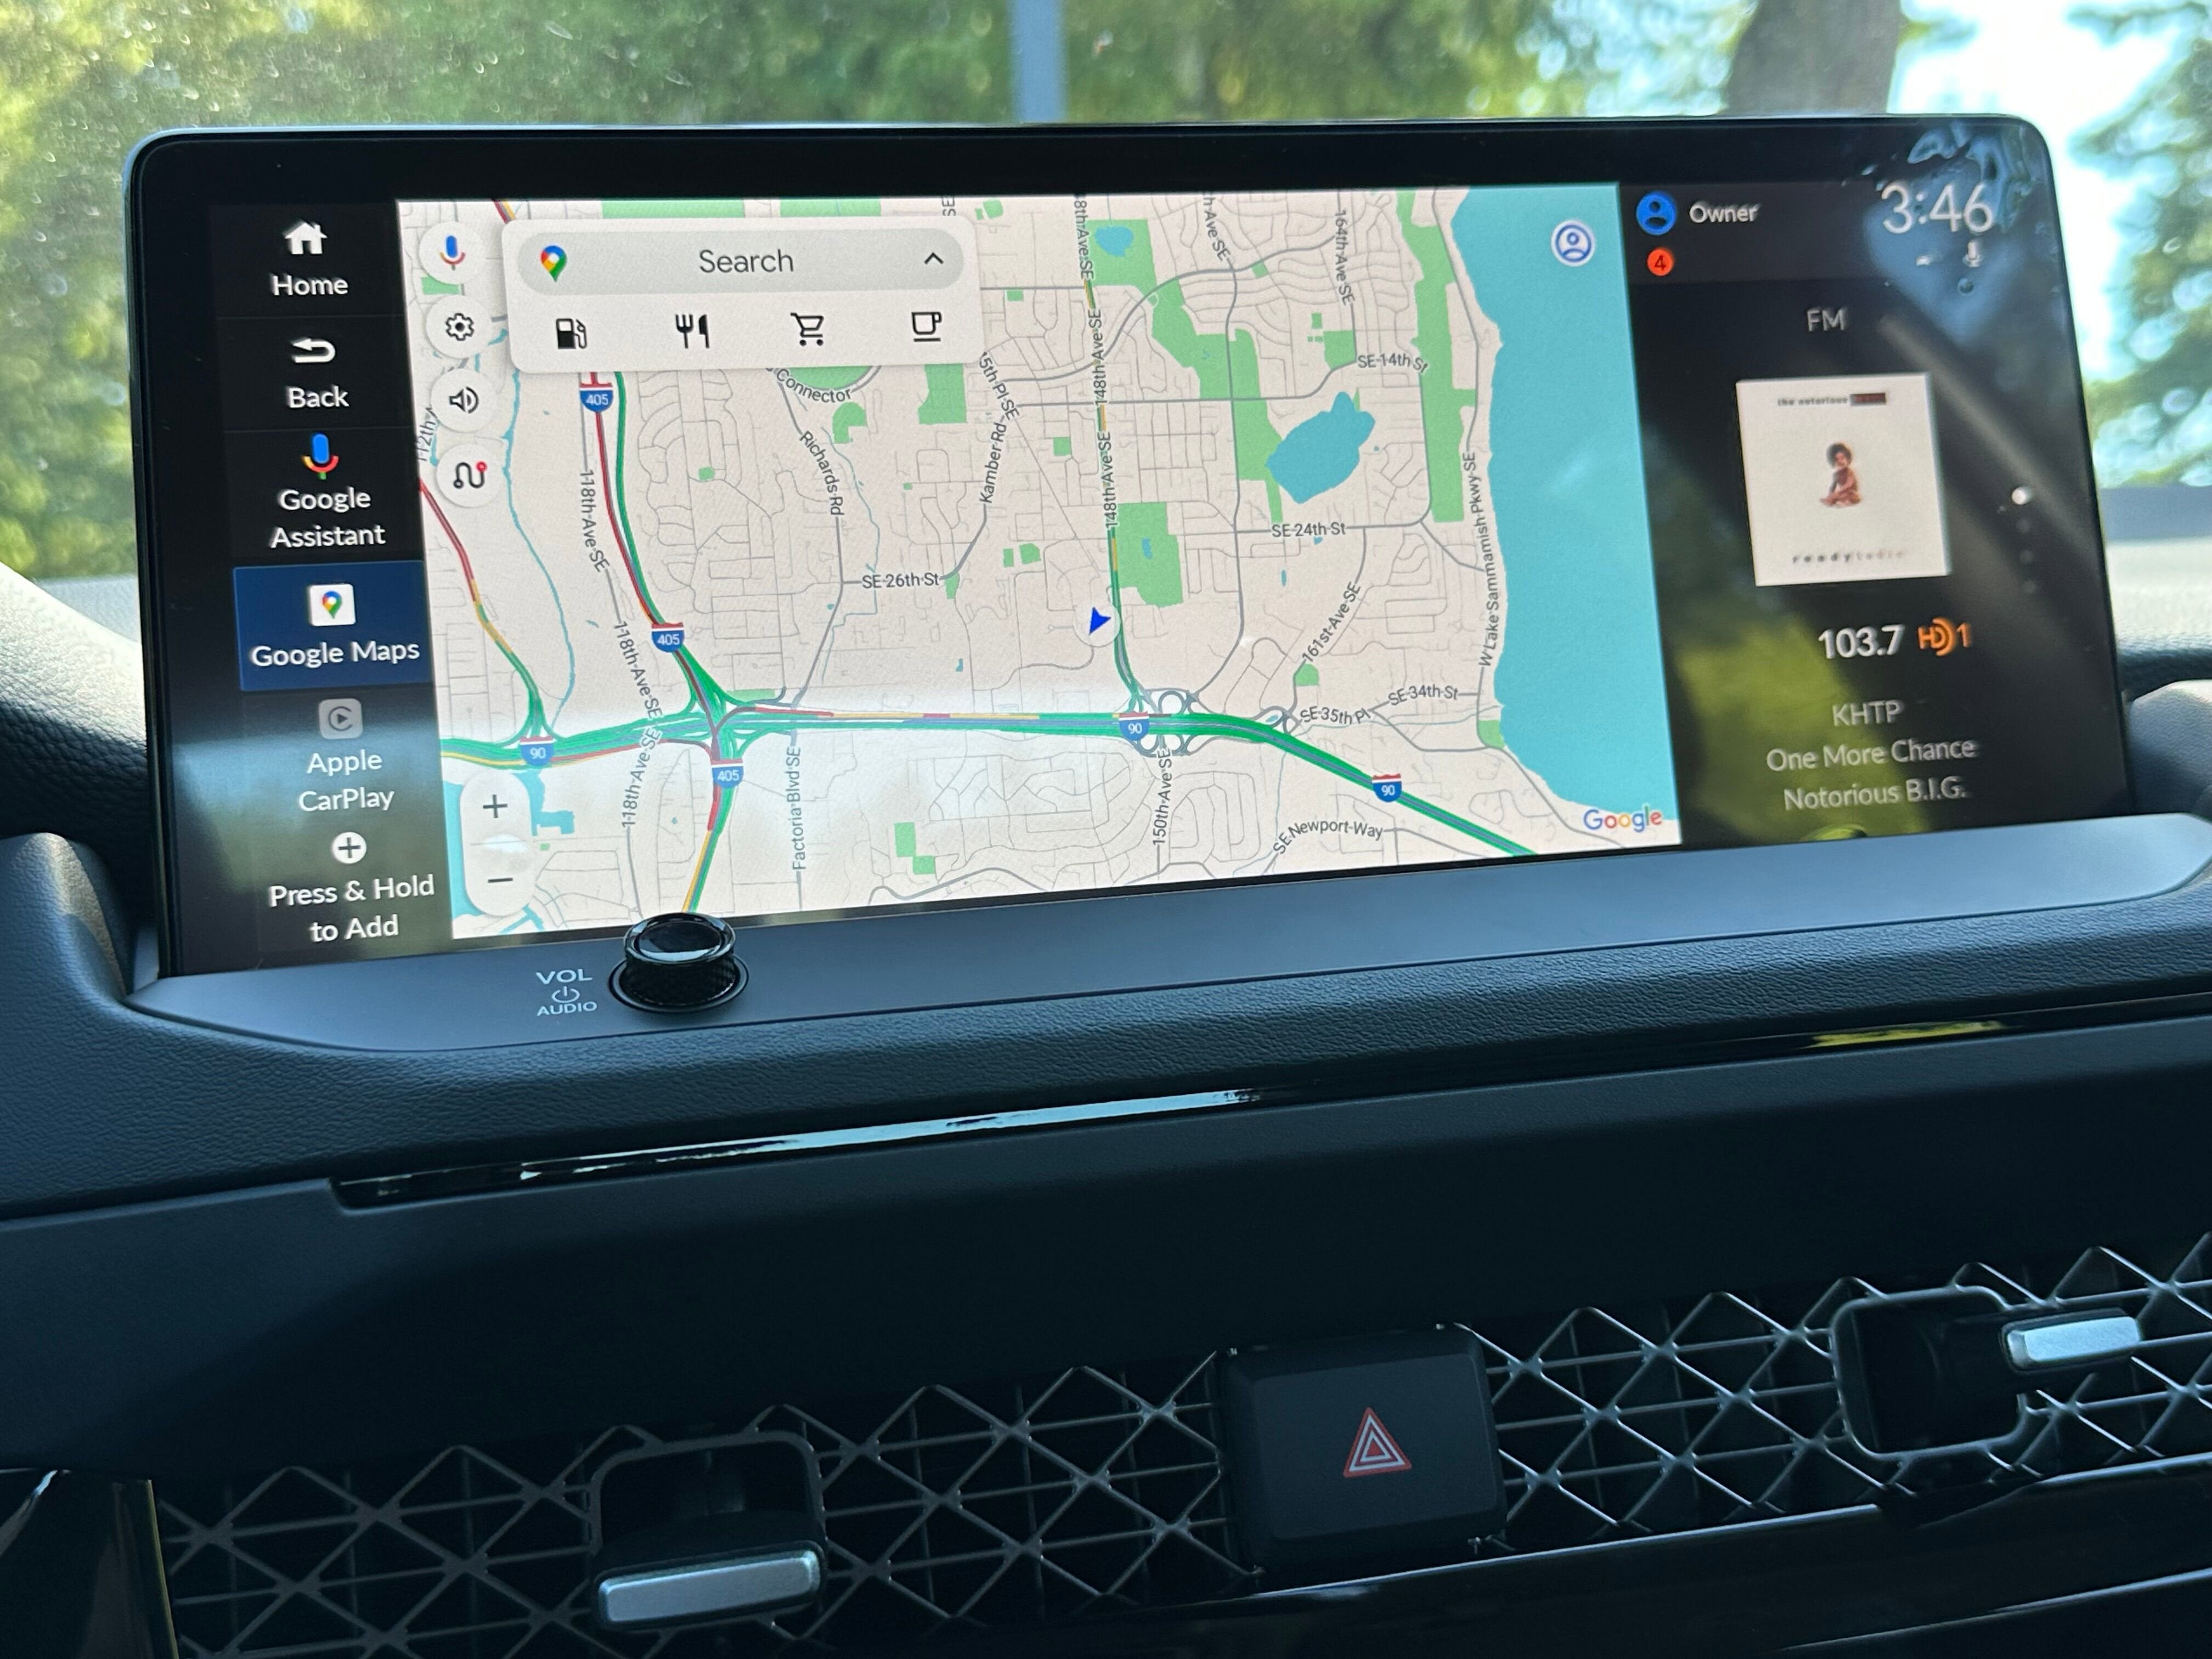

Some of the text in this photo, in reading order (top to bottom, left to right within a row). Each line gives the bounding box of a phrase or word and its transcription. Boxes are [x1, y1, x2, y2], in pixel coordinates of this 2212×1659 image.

[1690, 203, 1760, 223] Owner
[1882, 182, 1993, 234] 3:46
[1074, 196, 1094, 280] 8th Ave SE
[1204, 211, 1217, 238] Ave
[1211, 240, 1231, 262] SE
[699, 249, 794, 274] Search
[1335, 210, 1355, 306] 164th Ave SE
[1654, 256, 1666, 270] 4
[271, 275, 349, 296] Home
[1807, 308, 1845, 331] FM
[1088, 309, 1108, 406] 148th Ave SE
[1358, 354, 1429, 374] SE 14th St
[287, 386, 349, 409] Back
[585, 394, 609, 406] 405
[776, 369, 851, 403] Connector
[979, 352, 1020, 421] 5th Pl SE
[800, 431, 844, 516] Richards Rd
[979, 421, 1007, 504] Kamber Rd
[1098, 431, 1117, 528] 148th Ave SE
[279, 487, 371, 514] Google
[580, 470, 610, 573] 118th Ave SE
[1272, 522, 1346, 538] SE 24th St
[271, 525, 386, 549] Assistant
[1463, 452, 1500, 667] W Lake Sammamish Pkwy SE
[862, 572, 939, 589] SE 26th St
[1302, 581, 1361, 663] 161st Ave SE
[658, 634, 680, 646] 405
[1819, 624, 1904, 658] 103.7
[250, 640, 420, 669] Google Maps
[614, 621, 663, 719] 118th Ave SE
[1389, 685, 1458, 706] SE 34th St
[1300, 706, 1371, 725] SE 35th Pl
[1832, 700, 1902, 726] KHTP
[1127, 723, 1143, 734] 90
[307, 749, 382, 776] Apple
[529, 748, 546, 759] 90
[1767, 740, 1976, 772] One More Chance
[622, 727, 662, 828] 118th Ave SE
[717, 770, 740, 782] 405
[298, 788, 394, 813] CarPlay
[1153, 748, 1172, 845] 150th Ave SE
[1381, 785, 1395, 797] 90
[1784, 776, 1966, 811] Notorious B.I.G.
[786, 746, 806, 870] Factoria Blvd SE
[1583, 804, 1662, 832] Google
[1273, 821, 1383, 855] SE Newport Way
[269, 873, 435, 908] Press & Hold
[309, 915, 399, 943] to Add
[536, 969, 593, 985] VOL
[537, 1001, 597, 1017] AUDIO
